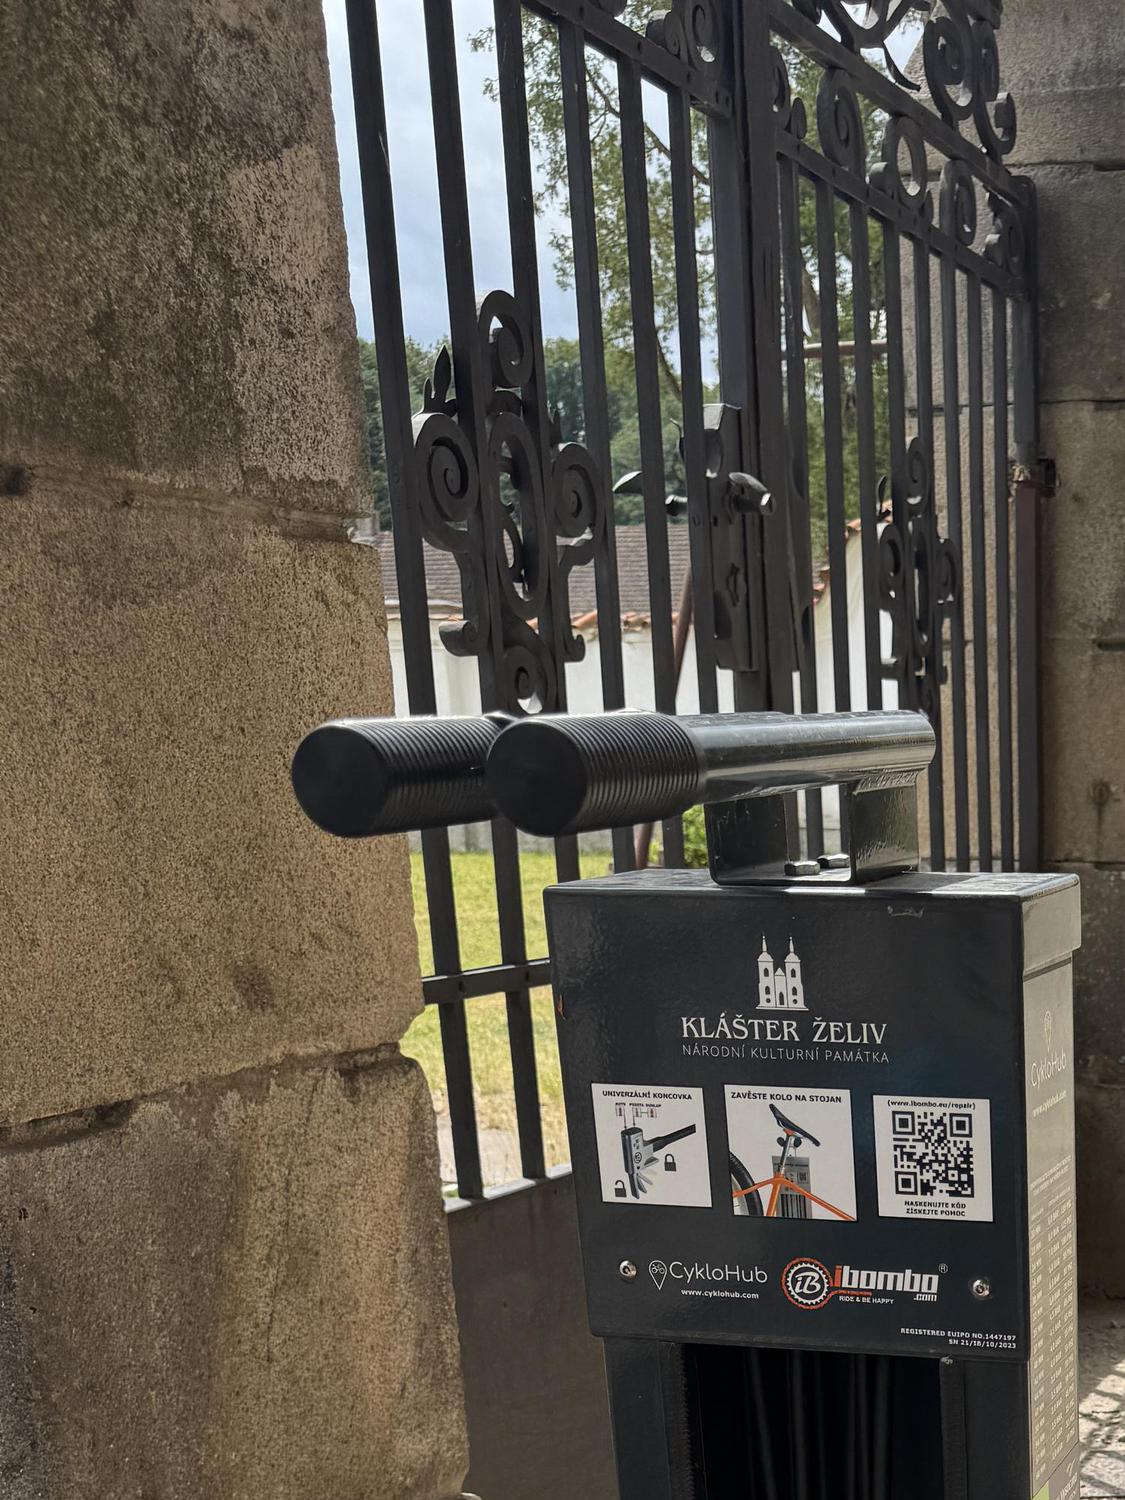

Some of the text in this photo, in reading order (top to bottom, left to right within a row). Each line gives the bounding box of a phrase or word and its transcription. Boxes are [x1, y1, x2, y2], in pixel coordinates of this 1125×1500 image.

[681, 1011, 888, 1045] KLÁŠTER ŽELIV
[682, 1042, 890, 1064] NÁRODNÍ KULTURNÍ PAMÁTKA
[602, 1090, 692, 1100] UNIVERZÁLNÍ KONCOVKA
[731, 1090, 842, 1104] ZAVĚSTE KOLO NA STOJAN
[904, 1200, 967, 1209] NASKENUJTE KÓD
[906, 1207, 938, 1216] ZÍSKEJTE
[669, 1261, 768, 1283] CykloHub
[834, 1265, 939, 1294] ibombo
[681, 1289, 759, 1299] www.cyklohub.com
[900, 1327, 946, 1337] REGISTERED
[947, 1330, 970, 1339] EUIPO
